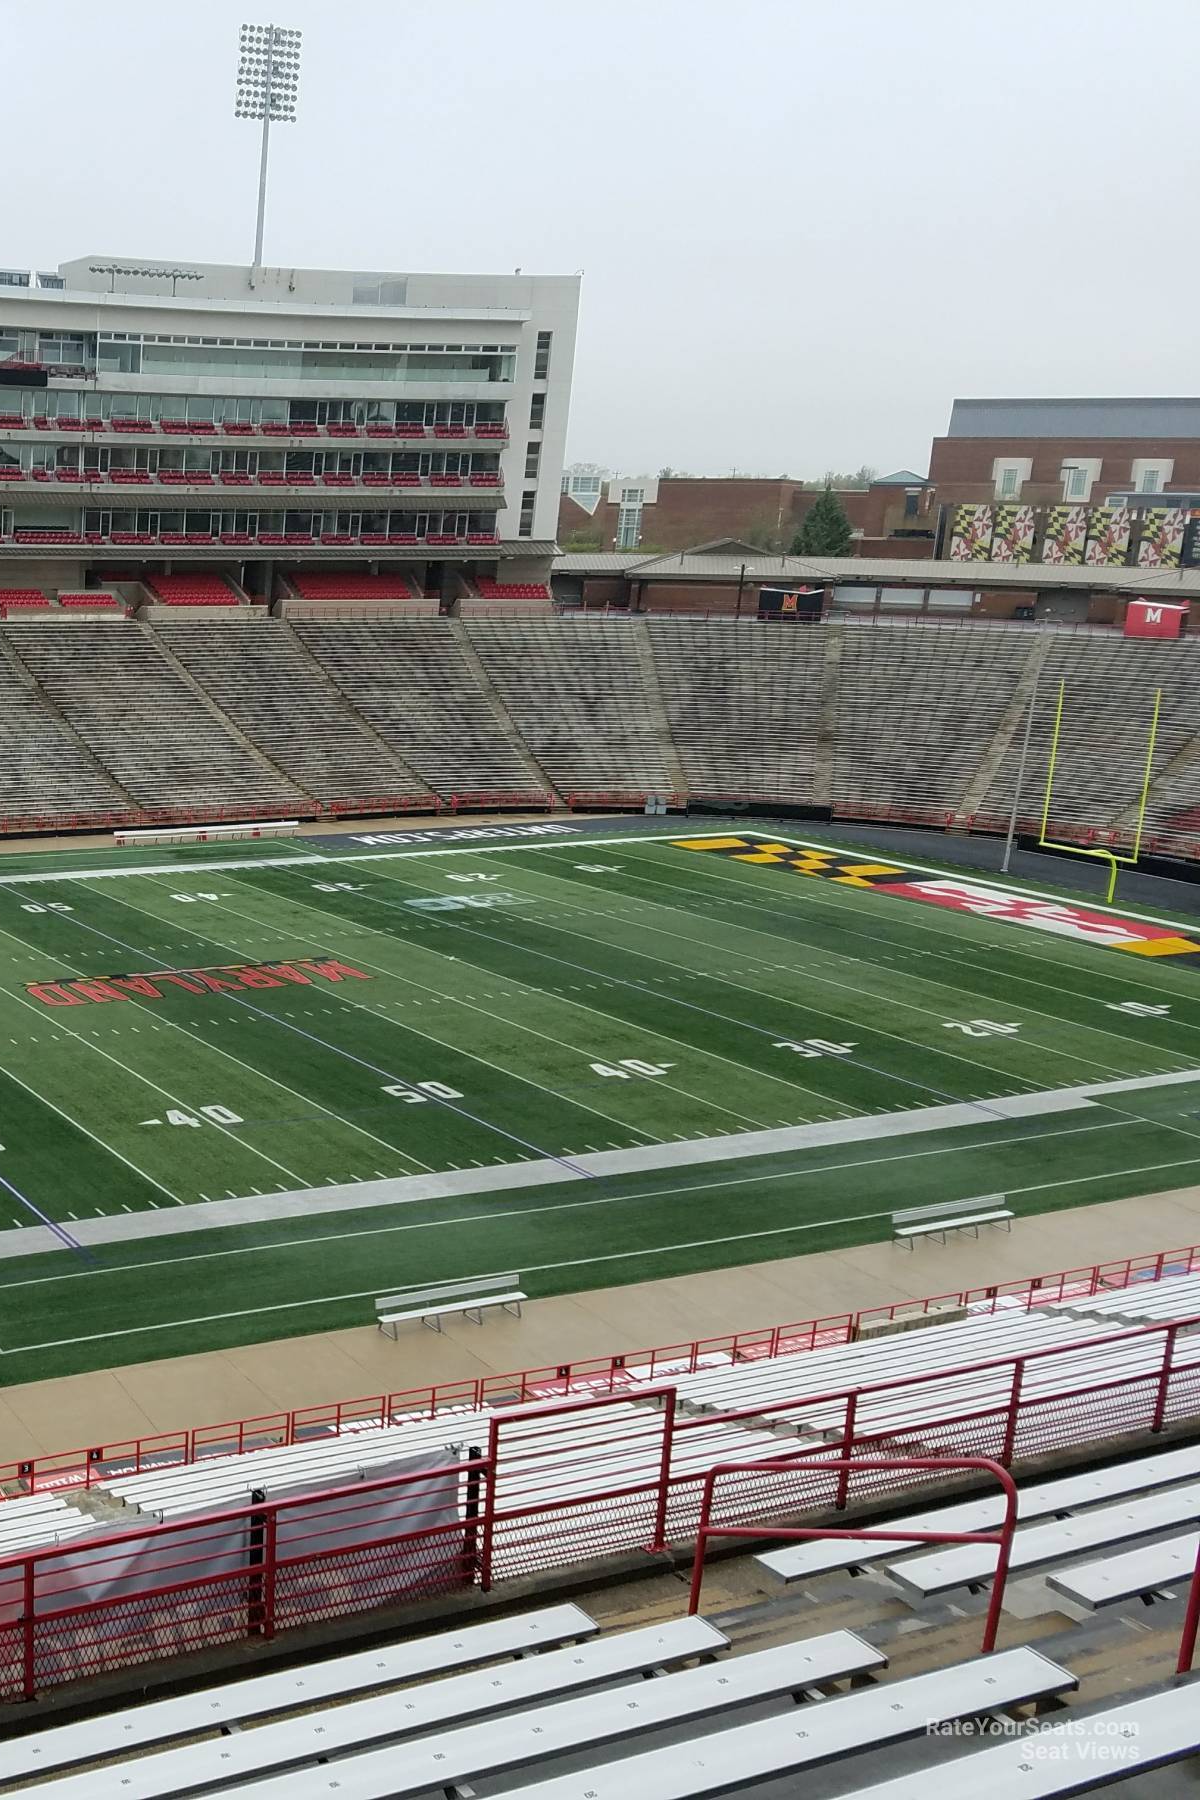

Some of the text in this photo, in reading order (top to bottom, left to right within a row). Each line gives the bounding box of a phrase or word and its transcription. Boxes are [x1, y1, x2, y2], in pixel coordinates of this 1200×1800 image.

[1145, 608, 1162, 623] M
[25, 959, 377, 1006] MARYLAND
[771, 1038, 853, 1058] 30
[589, 1059, 669, 1079] 40
[380, 1081, 464, 1103] 50
[165, 1104, 244, 1127] 40
